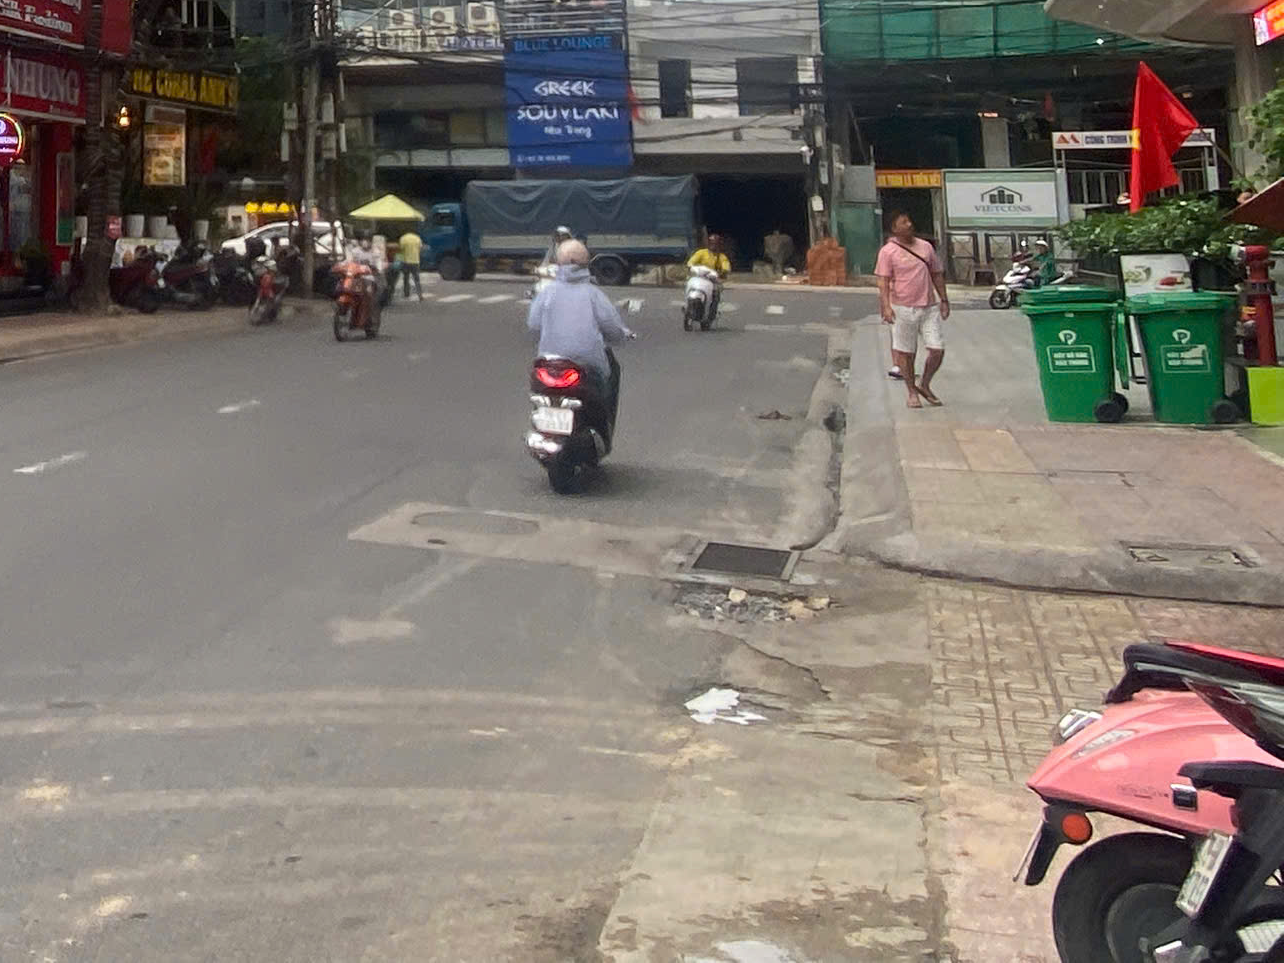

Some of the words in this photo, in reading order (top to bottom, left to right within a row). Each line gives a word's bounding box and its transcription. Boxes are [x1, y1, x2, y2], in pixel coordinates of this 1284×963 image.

[4, 55, 79, 106] NHUNG
[534, 80, 596, 96] GREEK
[974, 204, 1033, 213] VIETCONS
